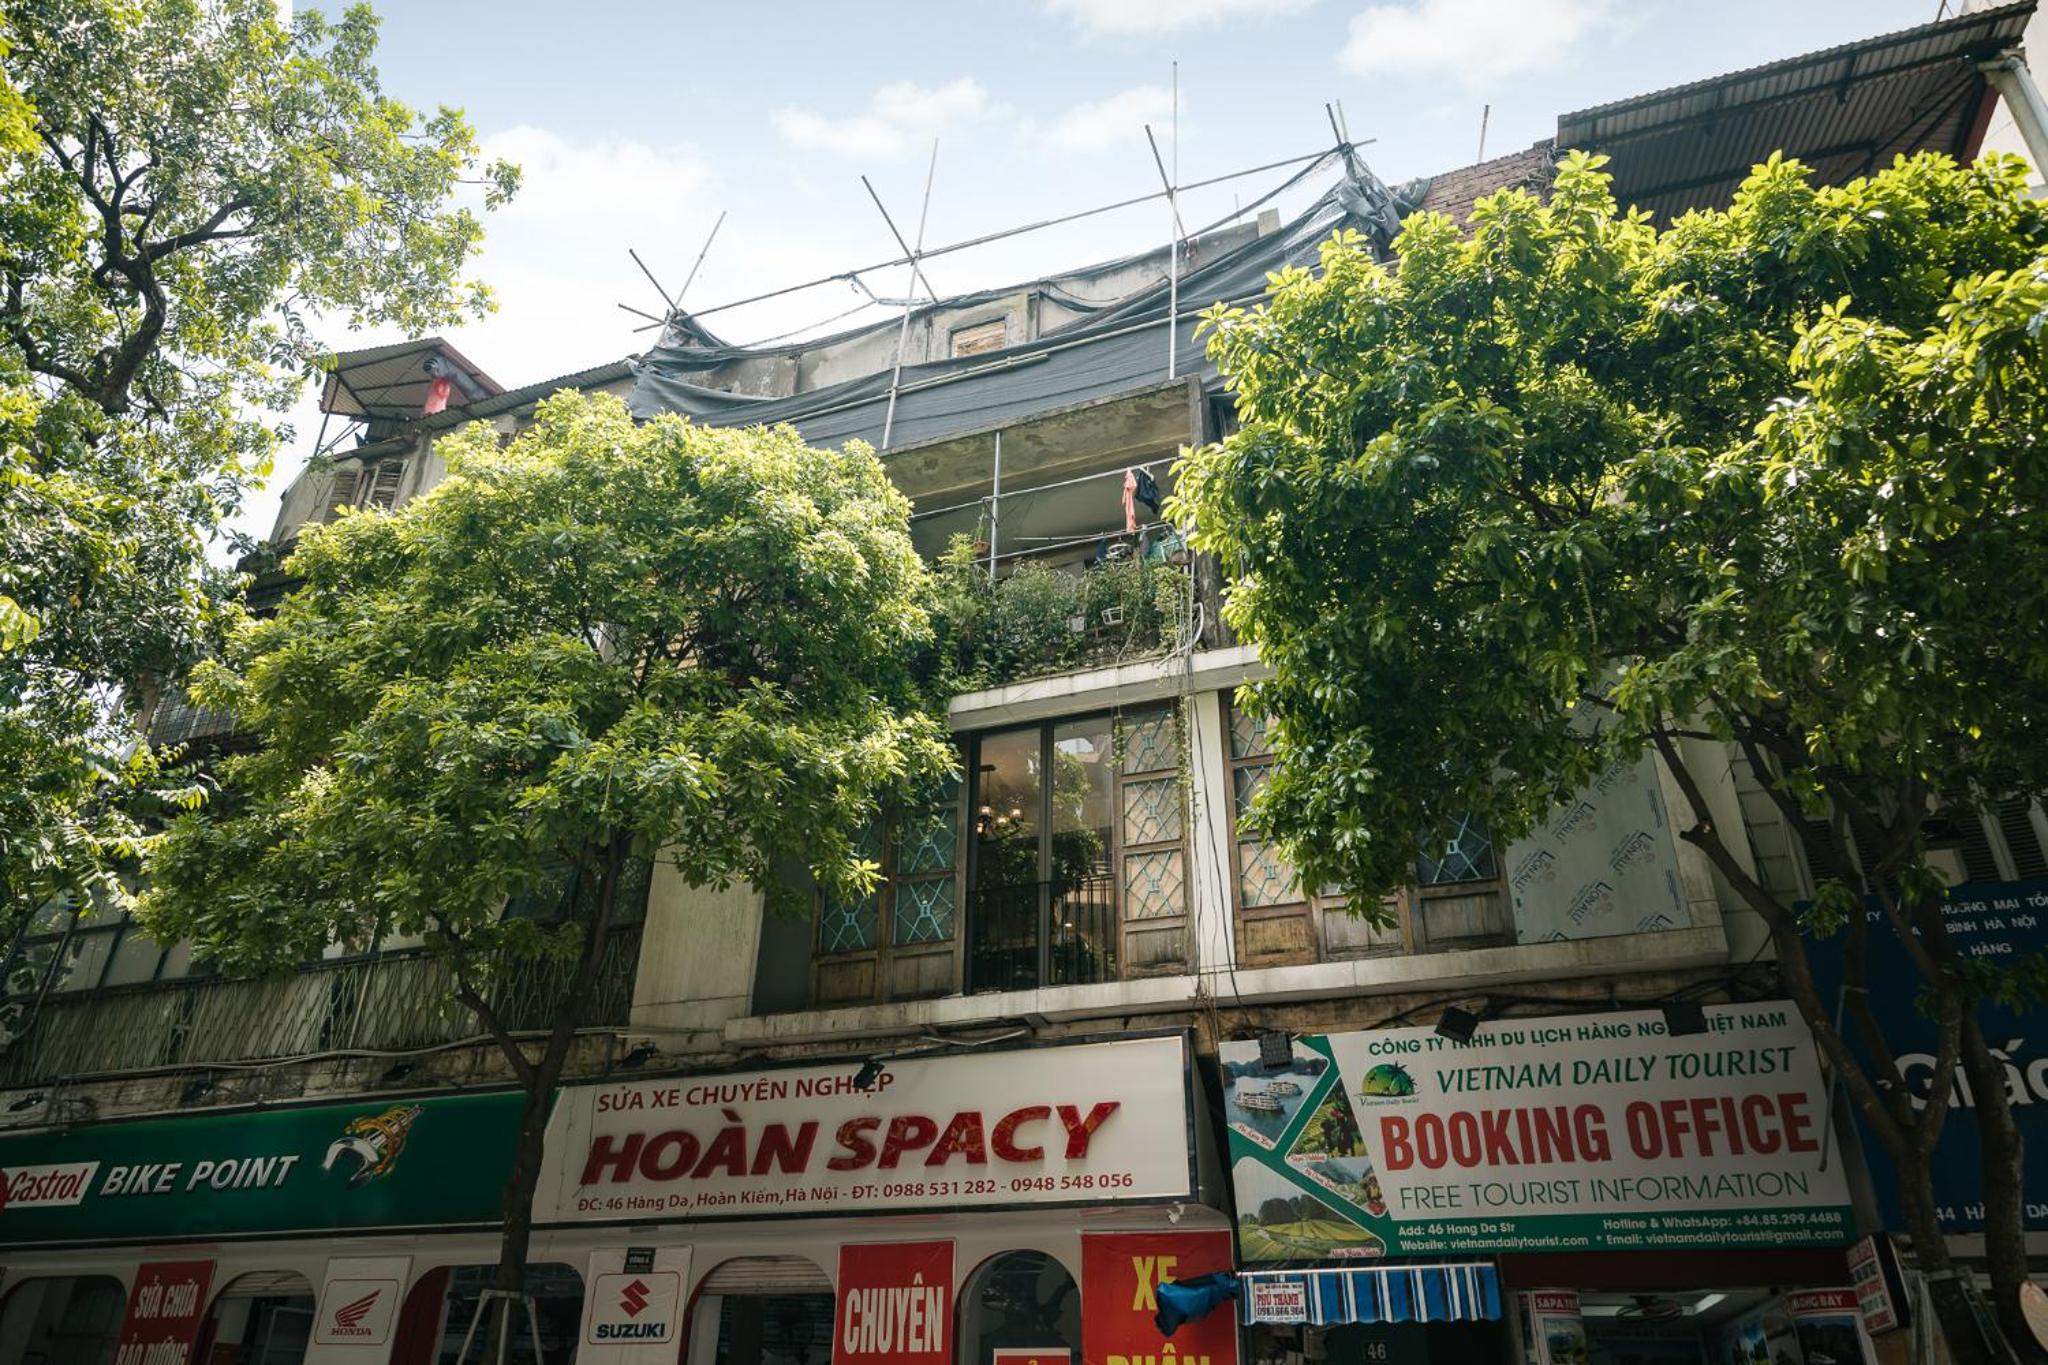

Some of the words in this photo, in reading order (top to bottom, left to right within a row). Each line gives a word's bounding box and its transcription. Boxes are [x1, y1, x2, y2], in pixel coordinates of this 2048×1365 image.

[1369, 1038, 1421, 1056] CÔNG
[1425, 1037, 1444, 1051] TY
[1501, 1030, 1526, 1046] DU
[1530, 1026, 1573, 1047] LỊCH
[1576, 1020, 1632, 1040] HÀNG
[1741, 1012, 1788, 1029] NAM
[1436, 1060, 1563, 1094] VIETNAM
[1572, 1053, 1656, 1086] DAILY
[1665, 1045, 1796, 1081] TOURIST
[597, 1087, 644, 1112] SỬA
[651, 1087, 681, 1108] XE
[686, 1077, 788, 1104] CHUYÊN
[795, 1072, 894, 1098] NGHP
[580, 1108, 820, 1185] HOÀN
[826, 1101, 1121, 1171] SPACY
[1380, 1103, 1612, 1171] BOOKING
[1625, 1092, 1820, 1160] OFFICE
[7, 1167, 89, 1202] Castrol
[100, 1162, 183, 1196] BIKE
[185, 1154, 300, 1192] POINT
[578, 1196, 602, 1211] ĐC:
[605, 1196, 623, 1210] 46
[626, 1194, 664, 1211] Hàng
[696, 1189, 736, 1206] Hoàn
[852, 1184, 878, 1200] ĐT:
[882, 1181, 925, 1198] 0988
[929, 1180, 959, 1196] 531
[964, 1179, 996, 1195] 282
[1010, 1175, 1056, 1192] 0948
[1061, 1173, 1095, 1190] 548
[1099, 1172, 1133, 1188] 056
[1400, 1184, 1463, 1210] FREE
[1469, 1179, 1581, 1207] TOURIST
[1590, 1171, 1810, 1203] INFORMATION
[1398, 1225, 1426, 1237] Add:
[1427, 1223, 1445, 1236] 46
[1602, 1217, 1646, 1230] Hotline
[1662, 1212, 1733, 1229] WhatsApp:
[1400, 1238, 1448, 1252] Website:
[1606, 1232, 1643, 1246] Email:
[331, 1327, 373, 1336] HONDA
[596, 1323, 666, 1338] SUZUKI
[843, 1271, 944, 1355] CHUYÊN
[1367, 1342, 1387, 1360] 46
